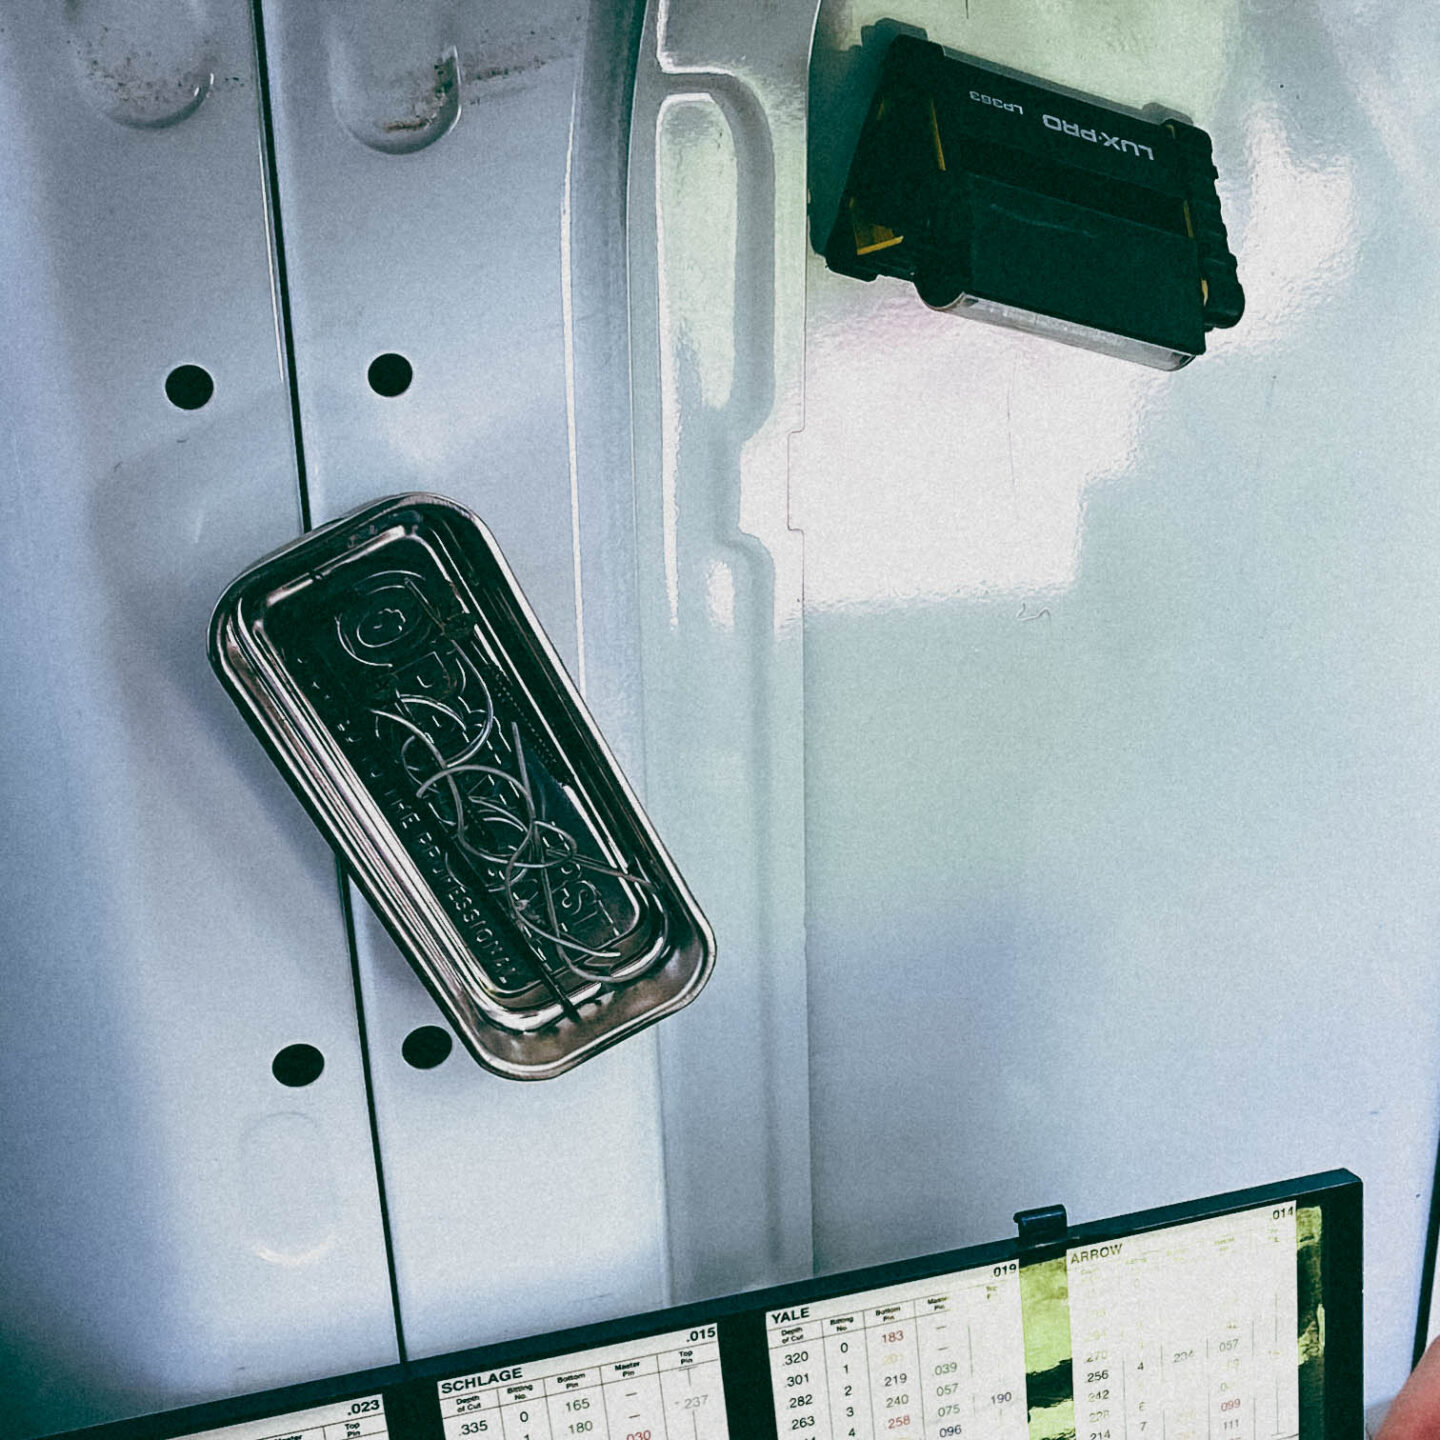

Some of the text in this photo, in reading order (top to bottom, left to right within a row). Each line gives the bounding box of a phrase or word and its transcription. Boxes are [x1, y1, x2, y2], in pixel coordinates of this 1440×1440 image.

[1070, 1243, 1123, 1264] ARROW
[771, 1306, 811, 1325] YALE
[441, 1367, 524, 1395] SCHLAGE
[347, 1399, 381, 1416] .023
